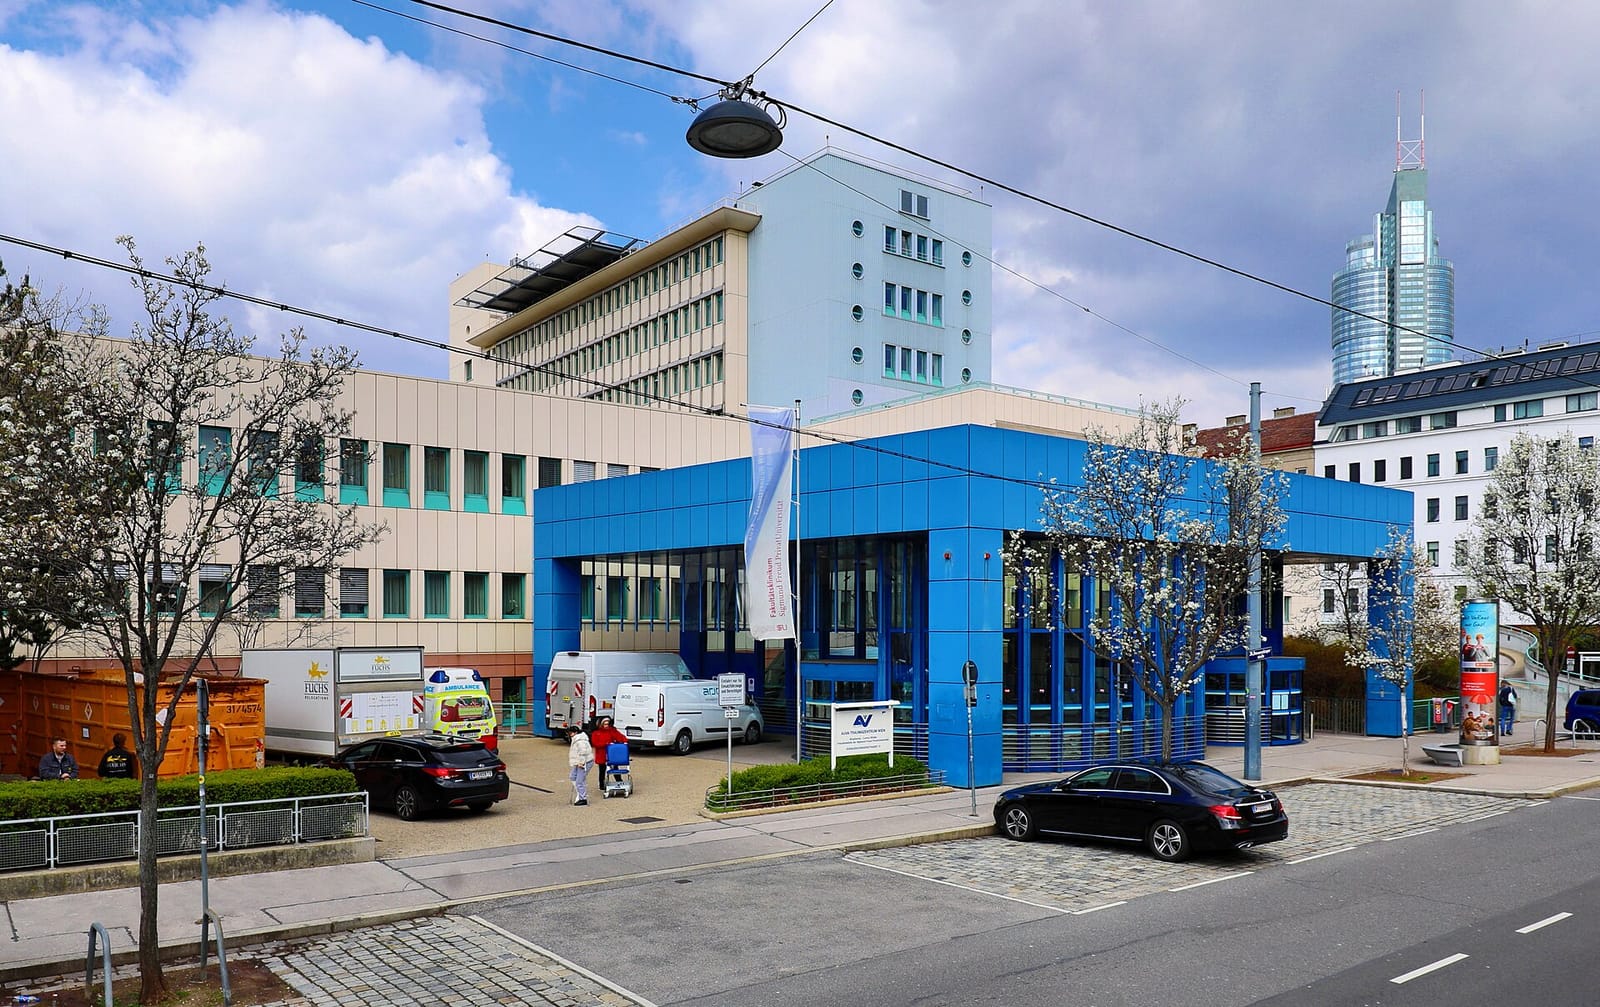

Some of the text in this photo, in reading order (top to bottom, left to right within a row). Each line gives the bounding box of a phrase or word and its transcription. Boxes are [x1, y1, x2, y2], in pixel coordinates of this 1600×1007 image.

[767, 557, 777, 618] Fakultätsklinikum
[778, 585, 786, 617] Sigmund
[304, 683, 329, 693] FUCHS
[226, 704, 262, 714] 31/4574
